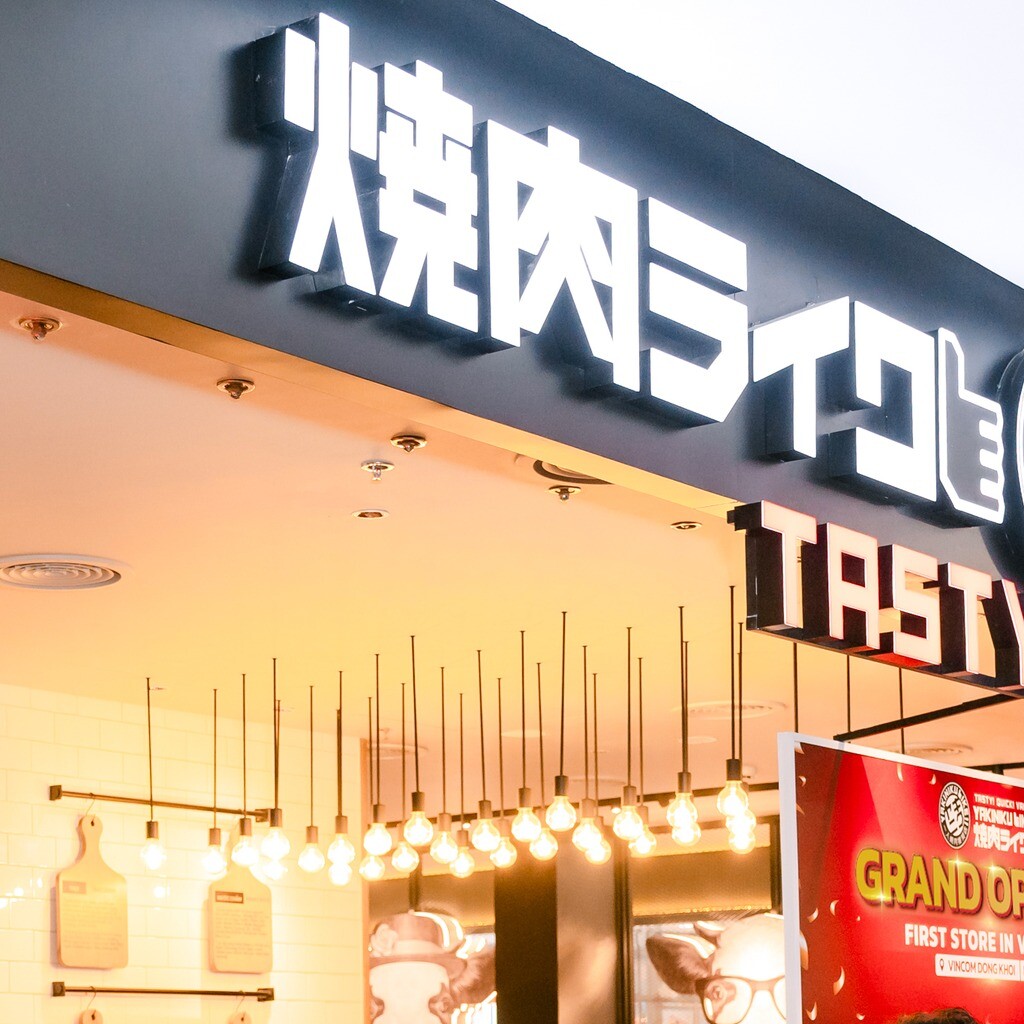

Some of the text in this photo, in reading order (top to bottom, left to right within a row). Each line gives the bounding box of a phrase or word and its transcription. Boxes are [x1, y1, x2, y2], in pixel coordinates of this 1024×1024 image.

[973, 805, 1013, 826] YAKINIKU
[855, 847, 982, 915] GRAND
[904, 923, 947, 948] FIRST
[950, 928, 997, 953] STORE
[1000, 933, 1014, 955] IN
[948, 959, 977, 974] VINCOM
[978, 962, 998, 975] DONG
[999, 964, 1016, 976] KHOI
